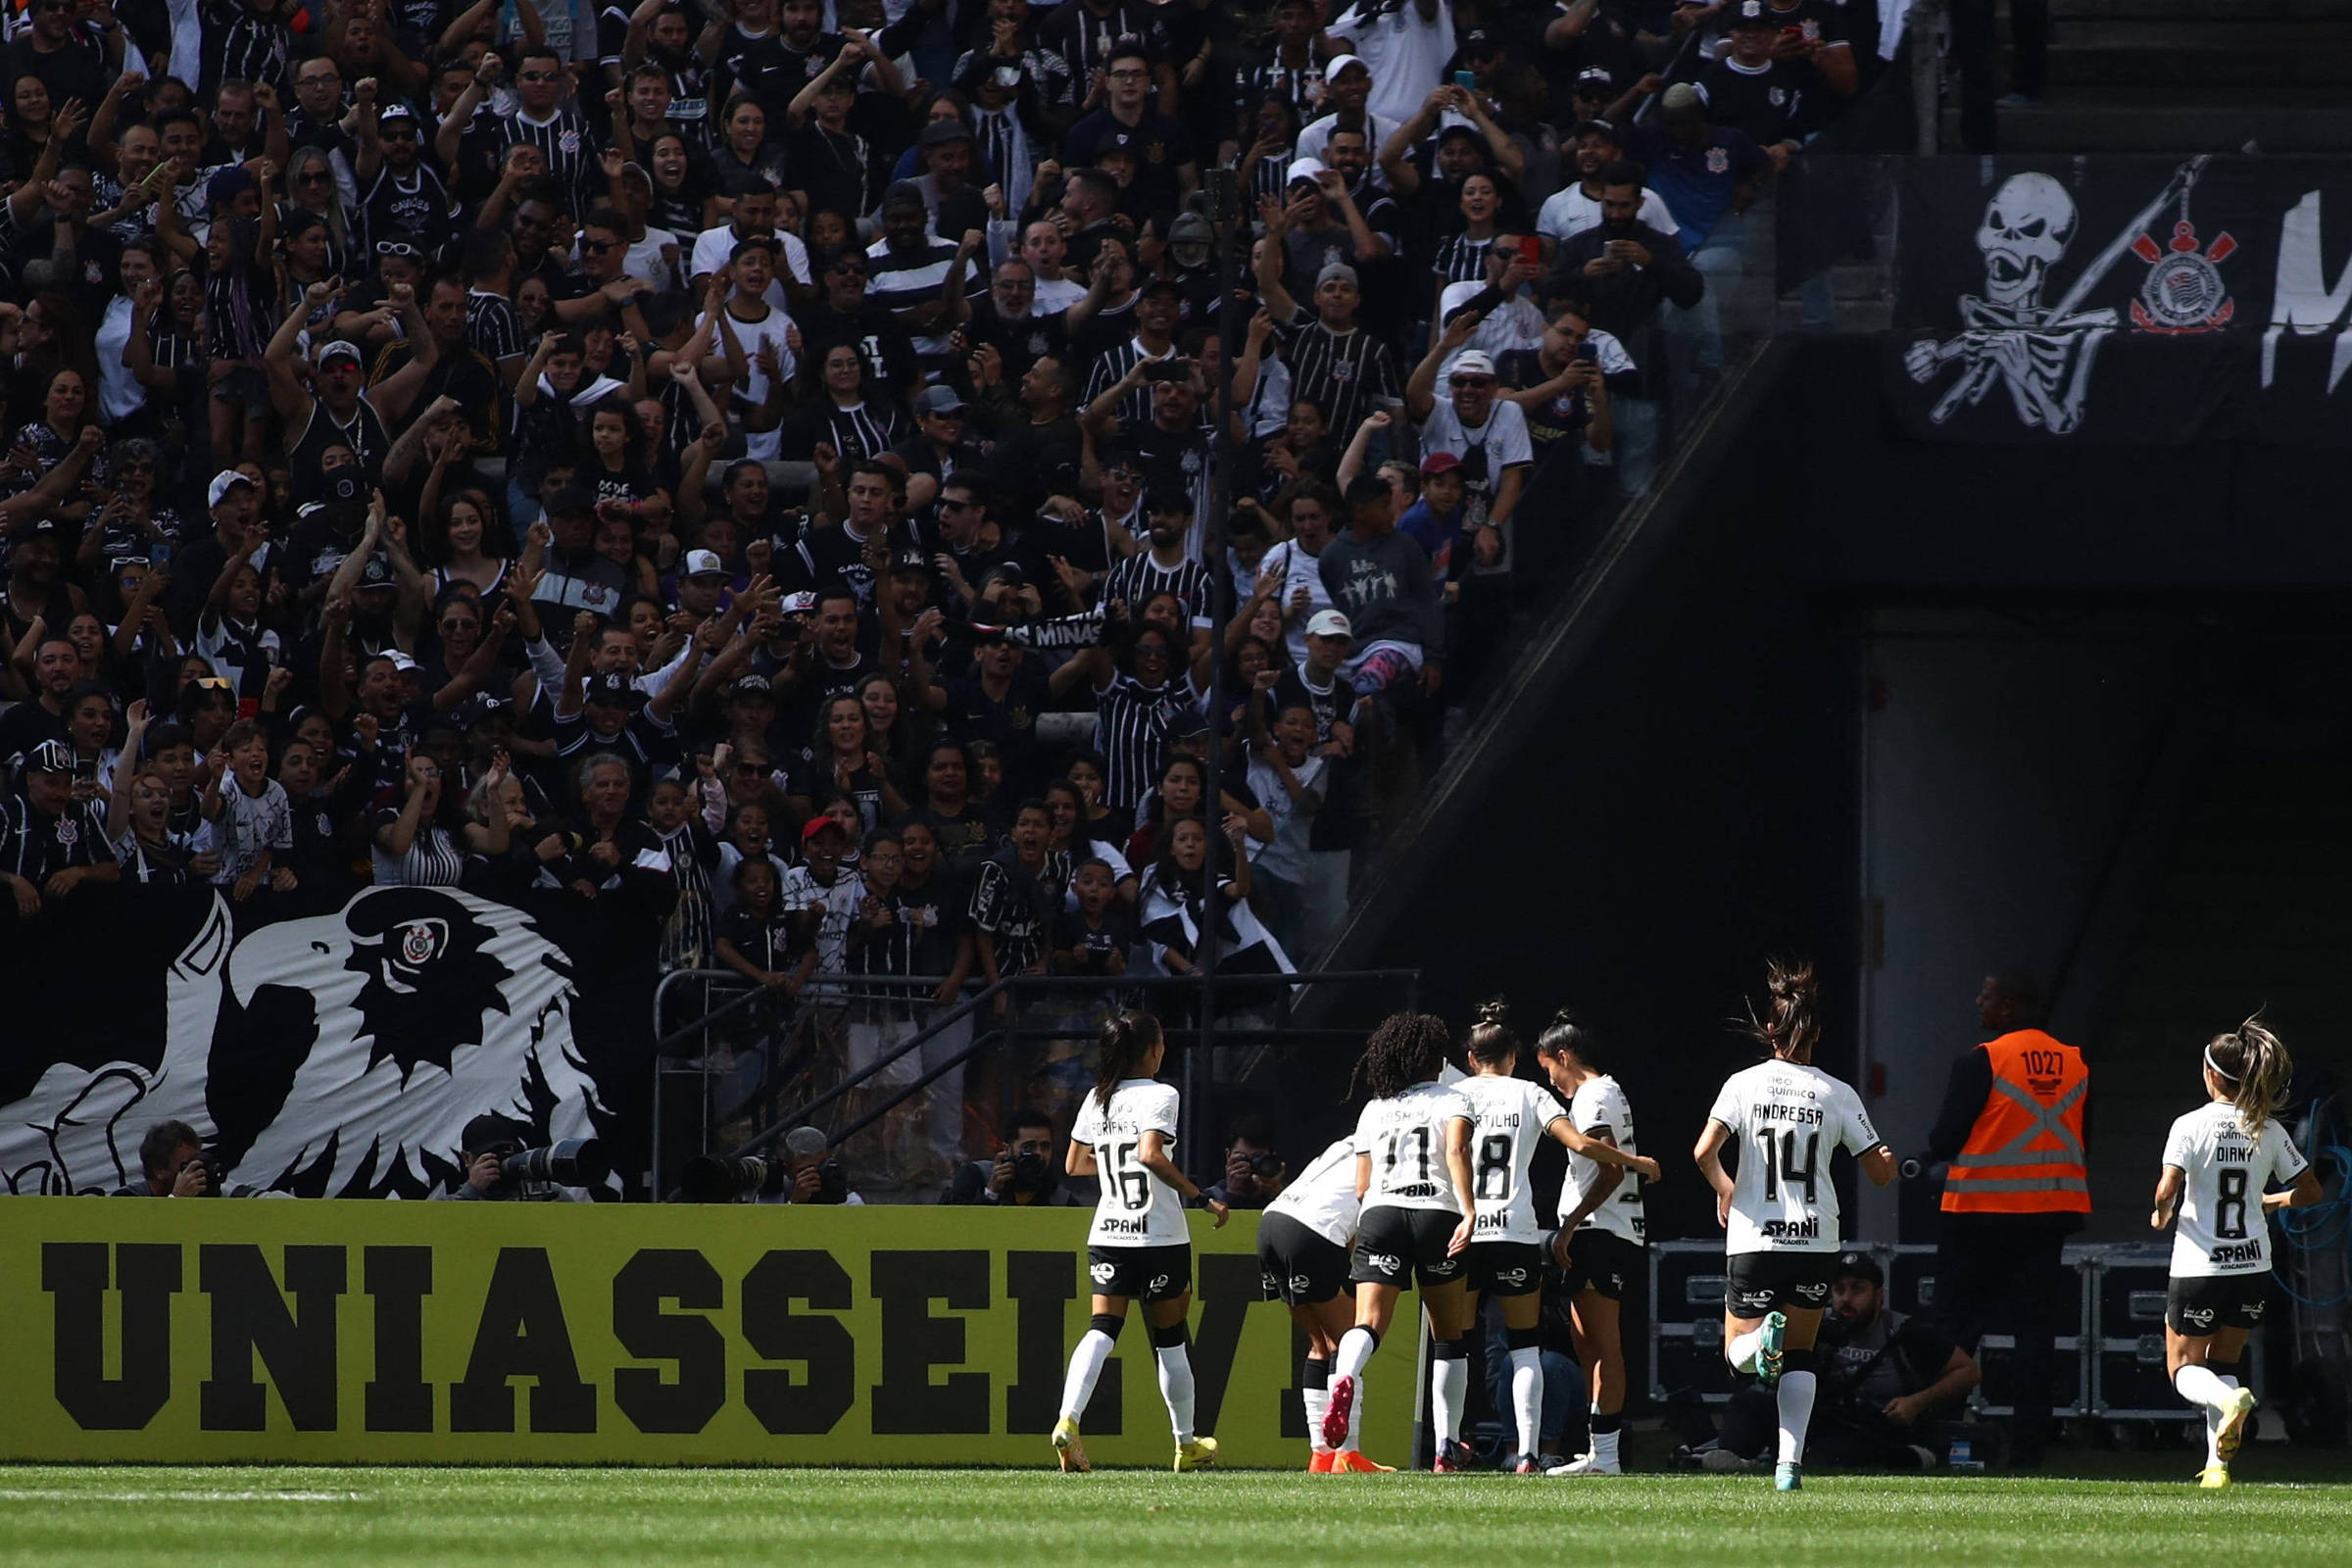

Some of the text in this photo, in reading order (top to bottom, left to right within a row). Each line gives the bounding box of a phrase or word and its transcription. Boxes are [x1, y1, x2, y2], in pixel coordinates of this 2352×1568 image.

[1035, 619, 1103, 648] MINAS
[2020, 1051, 2064, 1075] 1027
[1475, 1112, 1520, 1129] RTILHO
[1754, 1103, 1824, 1126] ANDRESSA
[1757, 1127, 1820, 1205] 14
[2217, 1147, 2254, 1163] DIANY
[1099, 1143, 1151, 1210] 16
[2215, 1168, 2248, 1239] 8
[1771, 1237, 1810, 1247] ATACADISTA
[2220, 1261, 2257, 1271] ATACADISTA
